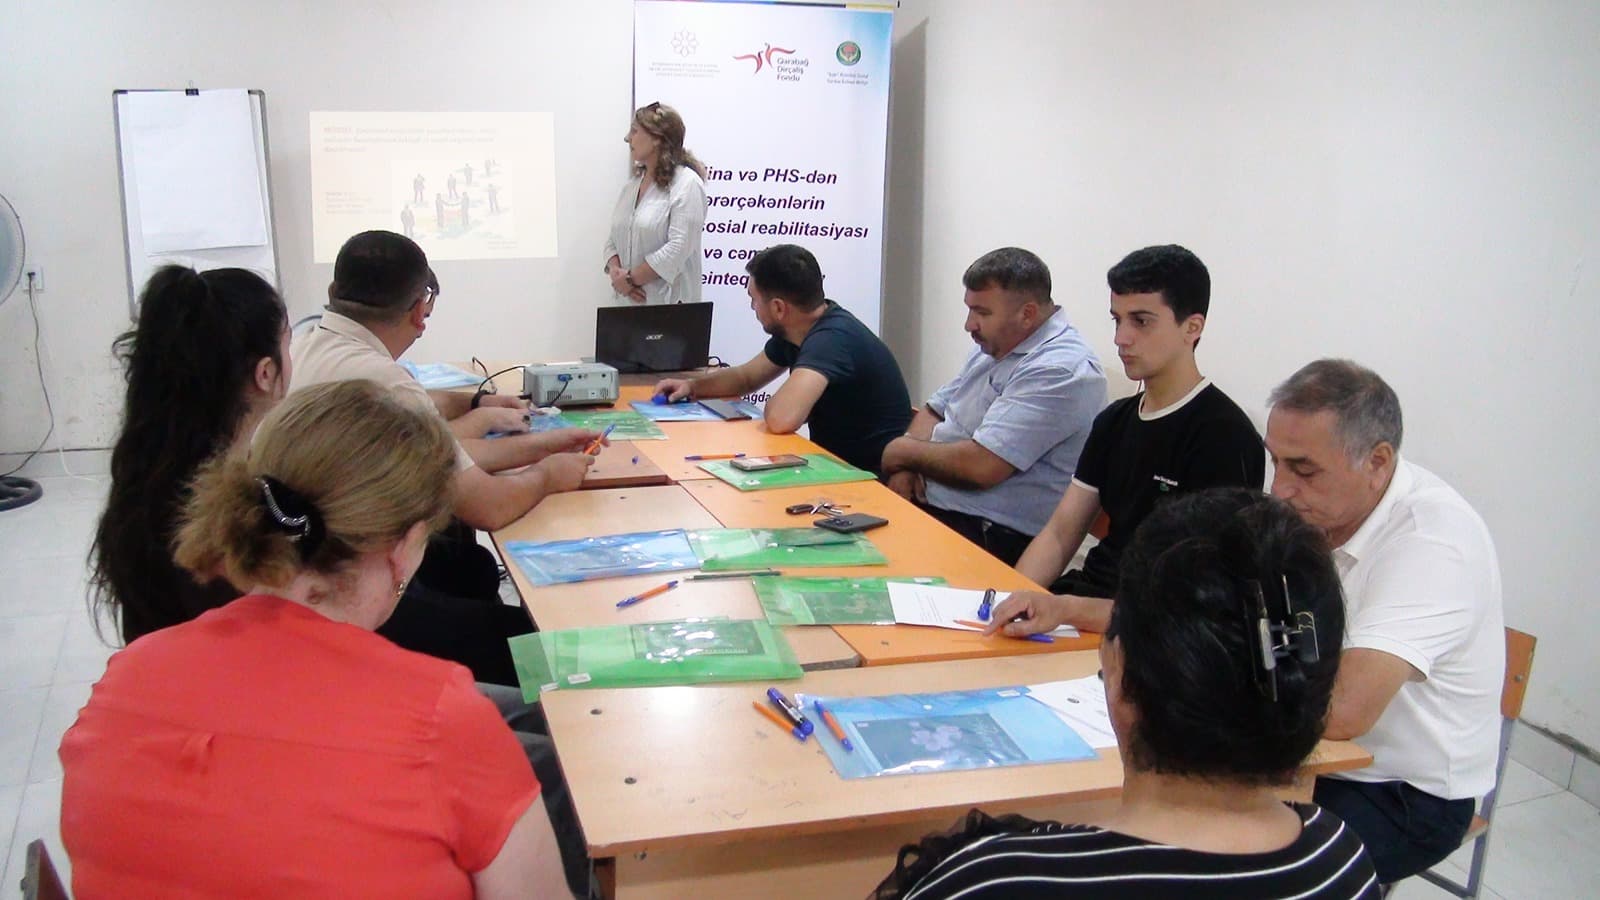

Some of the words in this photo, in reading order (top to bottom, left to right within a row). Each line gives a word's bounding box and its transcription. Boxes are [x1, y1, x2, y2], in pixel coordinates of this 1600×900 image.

[776, 73, 801, 82] Fondu
[704, 166, 733, 181] ina
[738, 169, 758, 182] və
[762, 168, 838, 185] PHS-dən
[705, 194, 825, 211] ərərçəkənlərin
[750, 221, 869, 240] reabilitasiyası
[703, 248, 723, 260] və
[645, 333, 664, 341] acer
